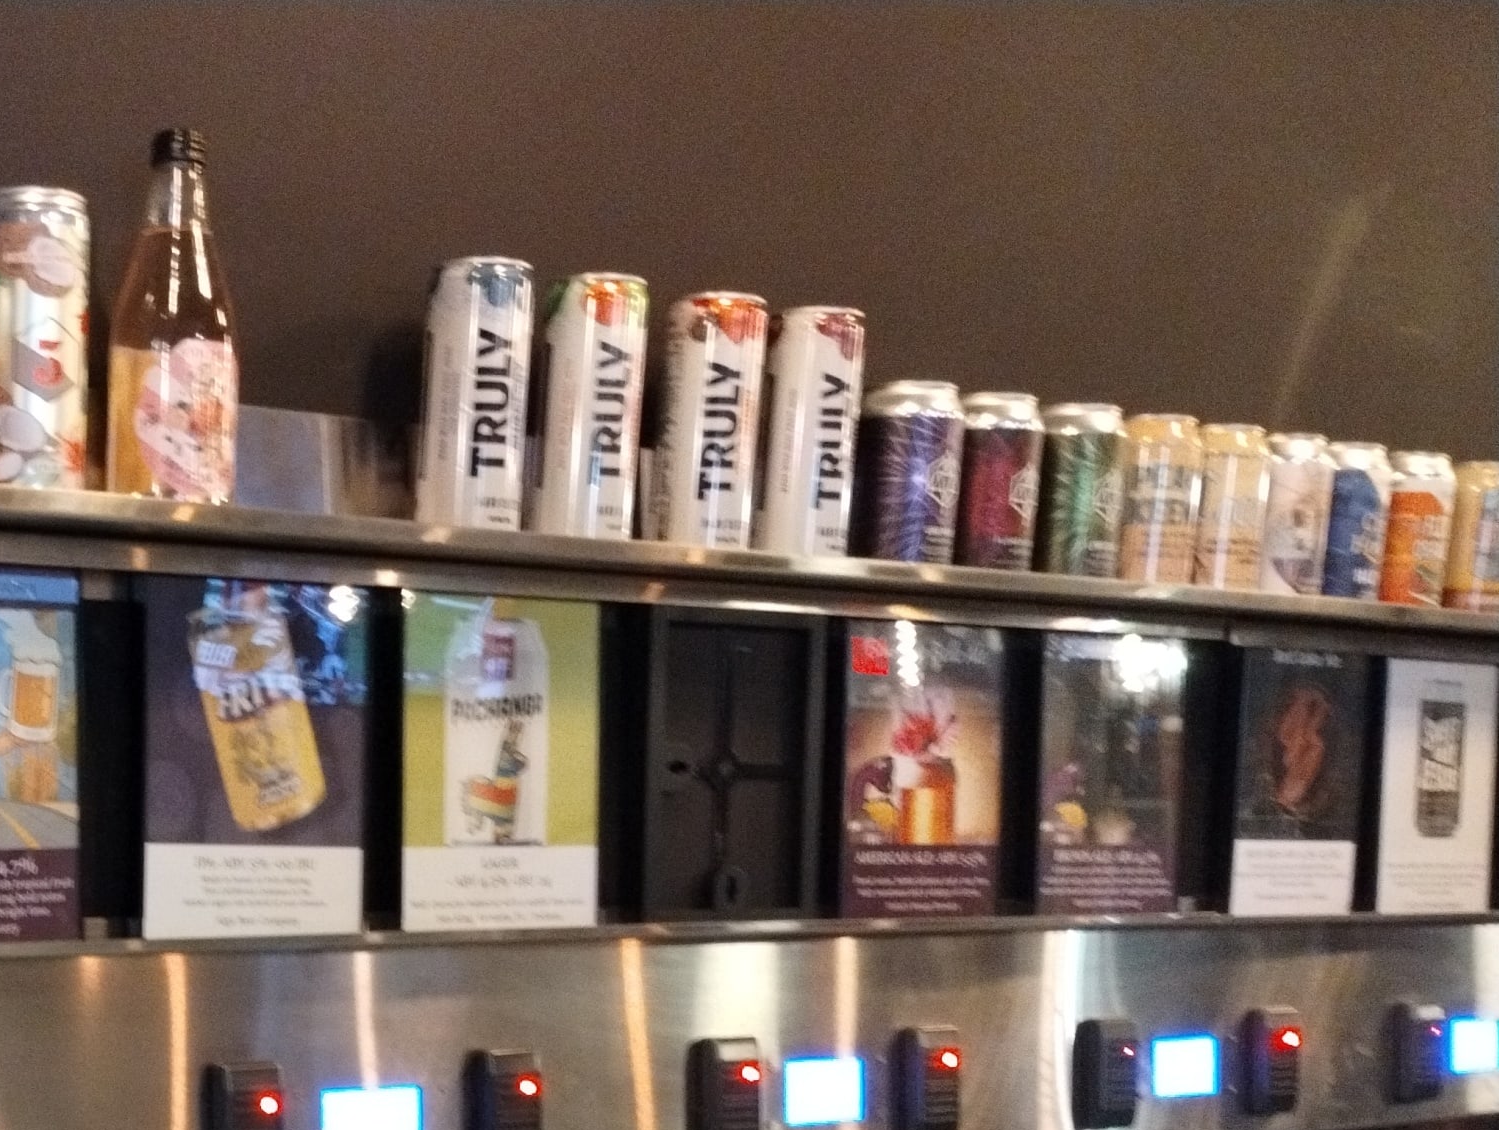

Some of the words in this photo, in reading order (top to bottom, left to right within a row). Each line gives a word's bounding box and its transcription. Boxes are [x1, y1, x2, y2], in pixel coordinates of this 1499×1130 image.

[470, 328, 513, 477] TRULY
[589, 341, 631, 485] TRULY
[698, 361, 743, 500] TRULY
[816, 373, 853, 509] TRULY
